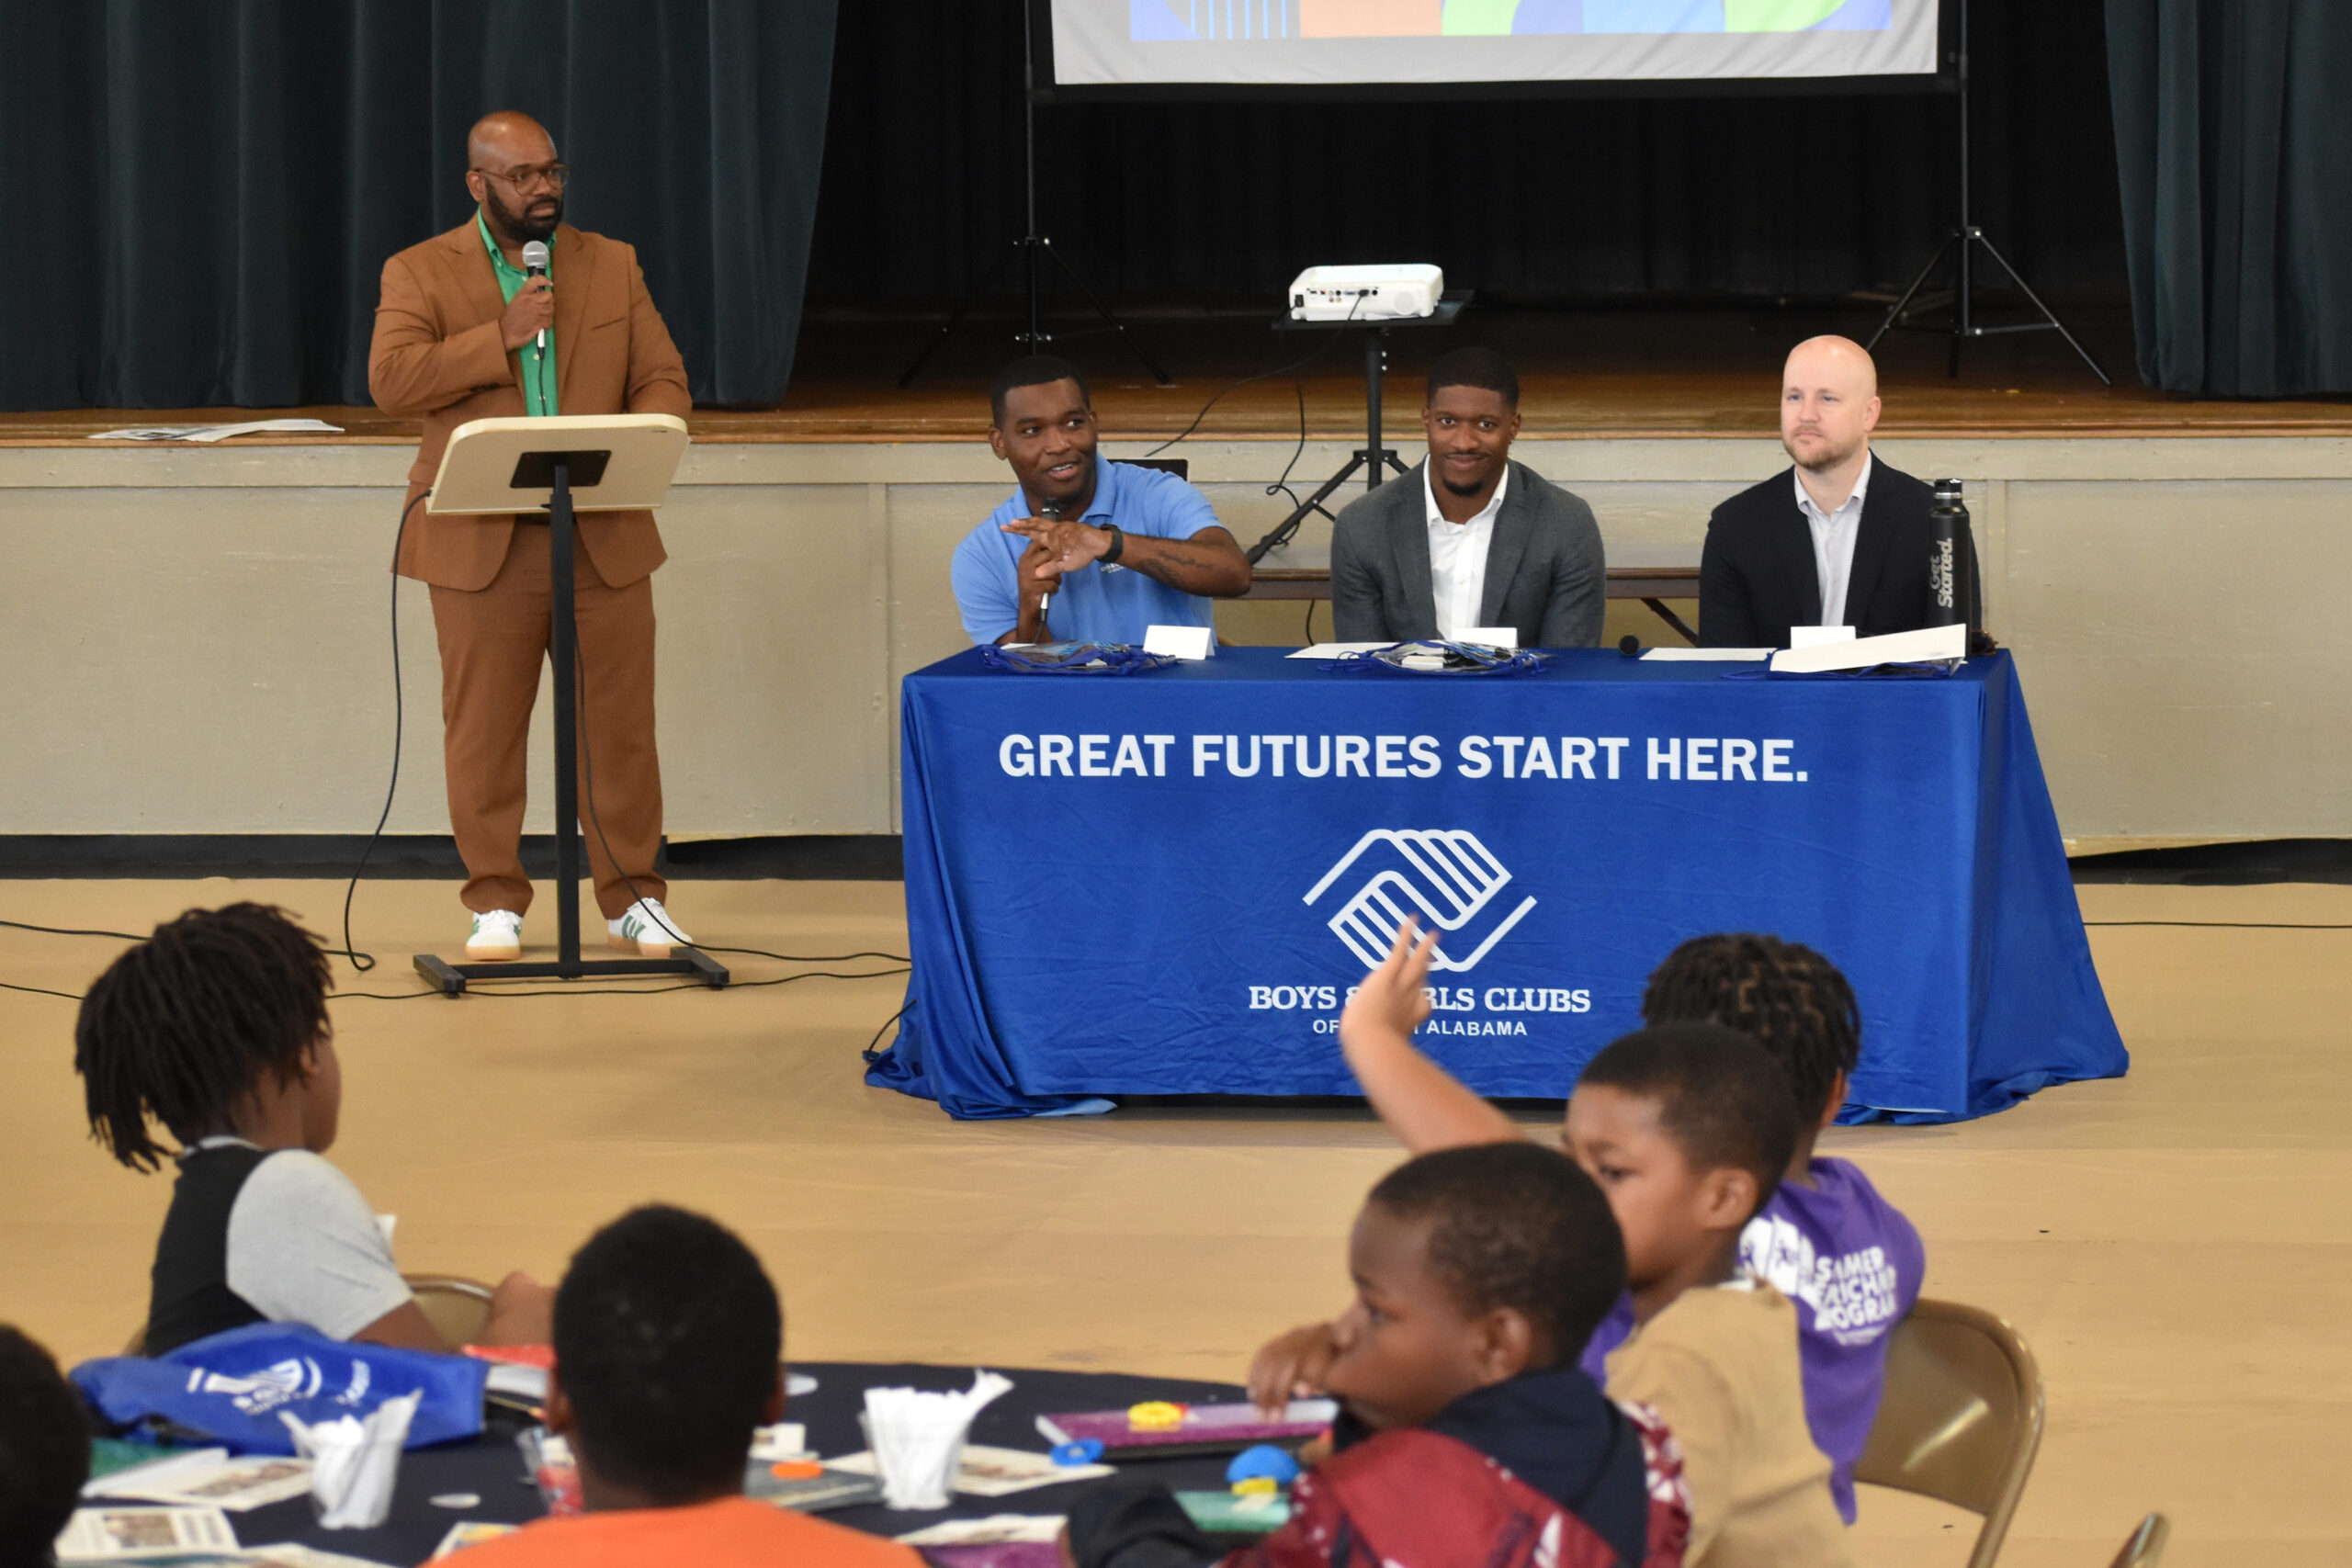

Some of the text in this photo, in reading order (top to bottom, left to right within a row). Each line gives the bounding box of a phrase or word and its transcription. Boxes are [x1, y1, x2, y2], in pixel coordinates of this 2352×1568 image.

[1937, 537, 1953, 608] Started.
[999, 734, 1808, 782] GREAT FUTURES START HERE.
[1249, 986, 1337, 1010] BOYS
[1484, 987, 1591, 1013] CLUBS
[1312, 1019, 1340, 1034] OF
[1426, 1020, 1528, 1036] ALABAMA
